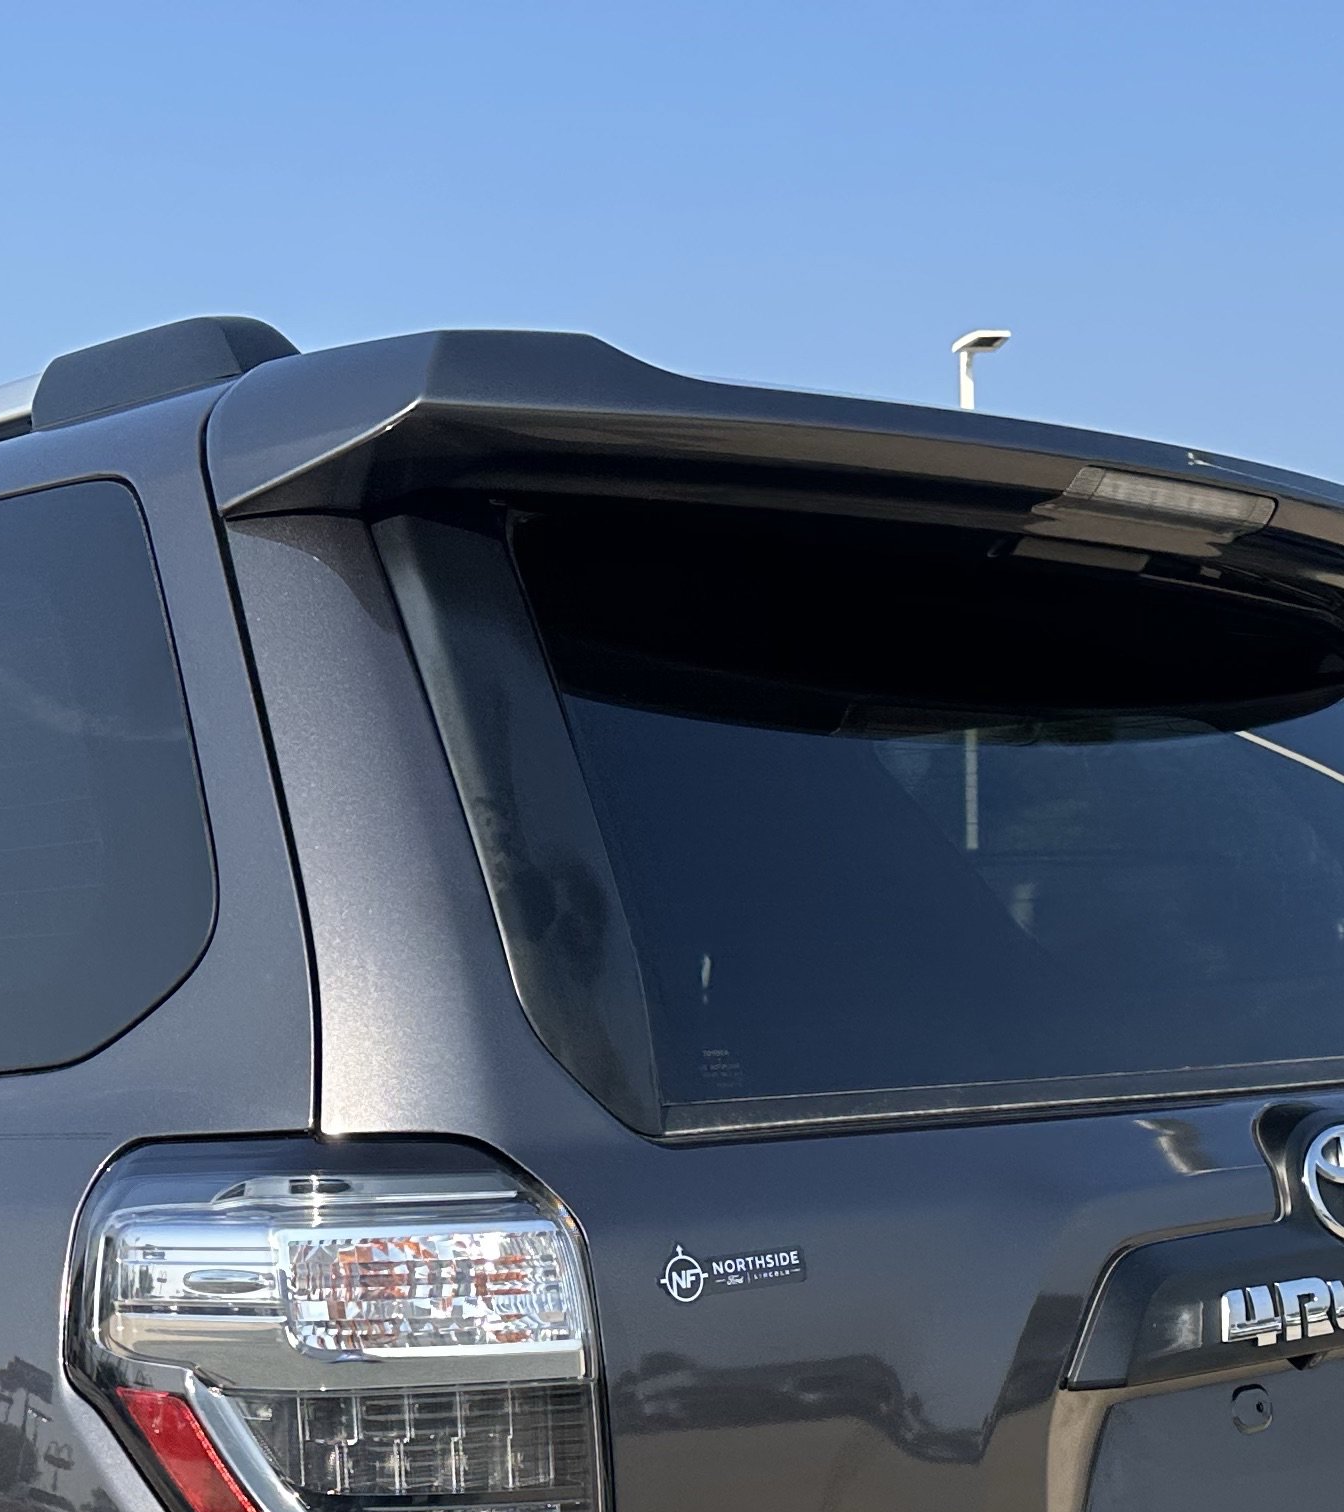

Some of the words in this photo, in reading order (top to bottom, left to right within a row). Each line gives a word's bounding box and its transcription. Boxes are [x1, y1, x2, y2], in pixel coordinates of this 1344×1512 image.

[712, 1250, 800, 1275] NORTHSIDE
[753, 1269, 790, 1280] LINCOLN
[671, 1268, 702, 1297] NF
